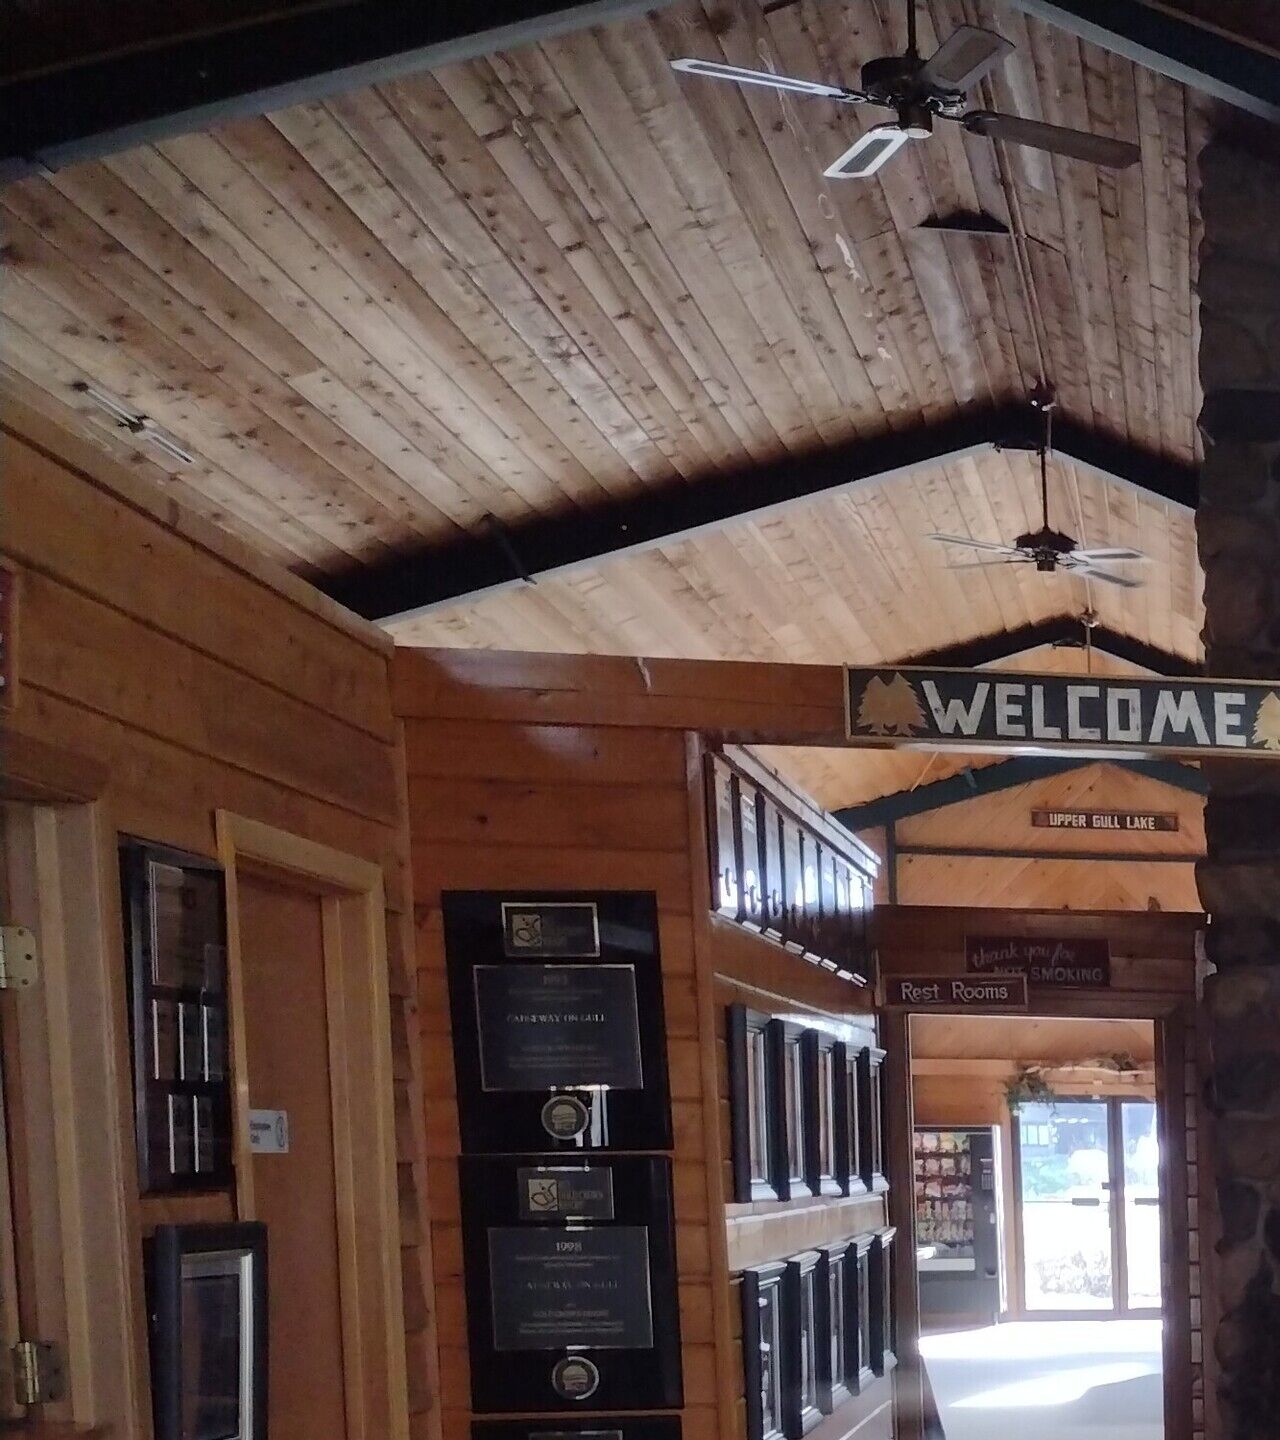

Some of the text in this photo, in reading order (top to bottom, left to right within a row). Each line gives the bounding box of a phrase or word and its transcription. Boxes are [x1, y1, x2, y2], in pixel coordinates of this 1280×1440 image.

[920, 680, 1248, 748] WELCOME
[1049, 812, 1156, 831] UPPER GULL LAKE
[972, 941, 1019, 969] thank
[1023, 944, 1050, 964] you
[1030, 967, 1104, 983] SMOKING
[900, 981, 1008, 1003] Rest Rooms
